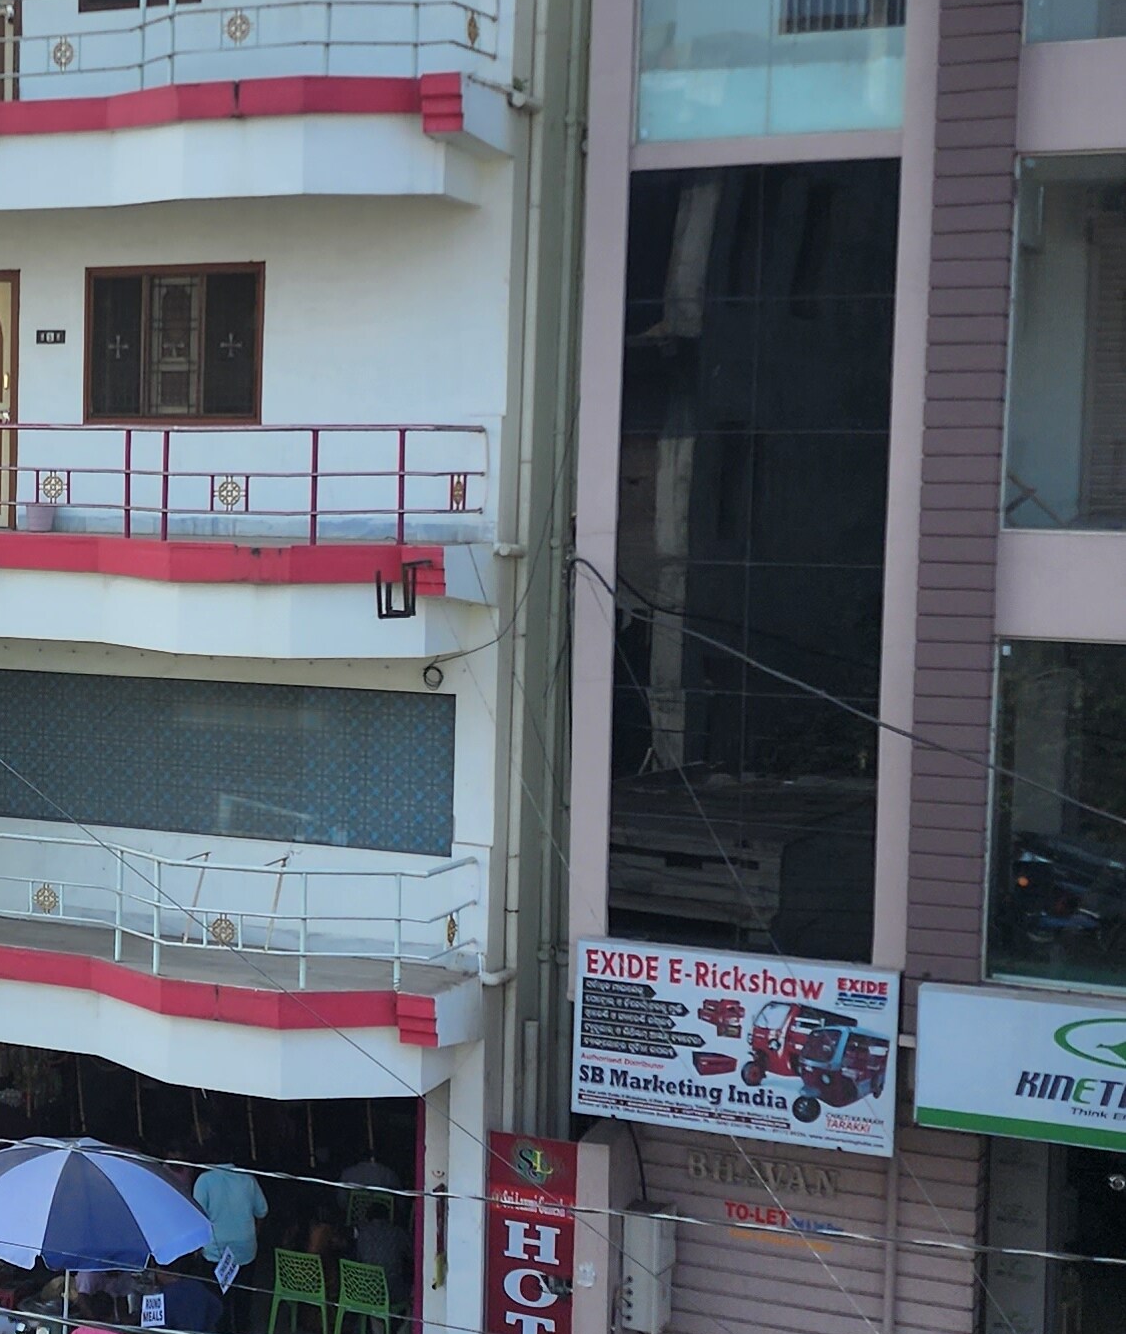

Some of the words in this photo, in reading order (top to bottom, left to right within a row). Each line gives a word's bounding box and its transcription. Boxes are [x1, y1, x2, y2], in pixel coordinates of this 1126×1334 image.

[586, 949, 659, 982] EXIDE
[668, 958, 824, 1001] E-Rickshaw
[837, 976, 889, 996] EXIDE
[579, 1064, 605, 1085] SB
[609, 1068, 723, 1105] Marketing
[727, 1084, 789, 1111] India
[1072, 1106, 1108, 1120] Think
[827, 1117, 872, 1134] TARAKKI
[724, 1201, 790, 1227] TO-LET
[142, 1310, 163, 1322] MEALS
